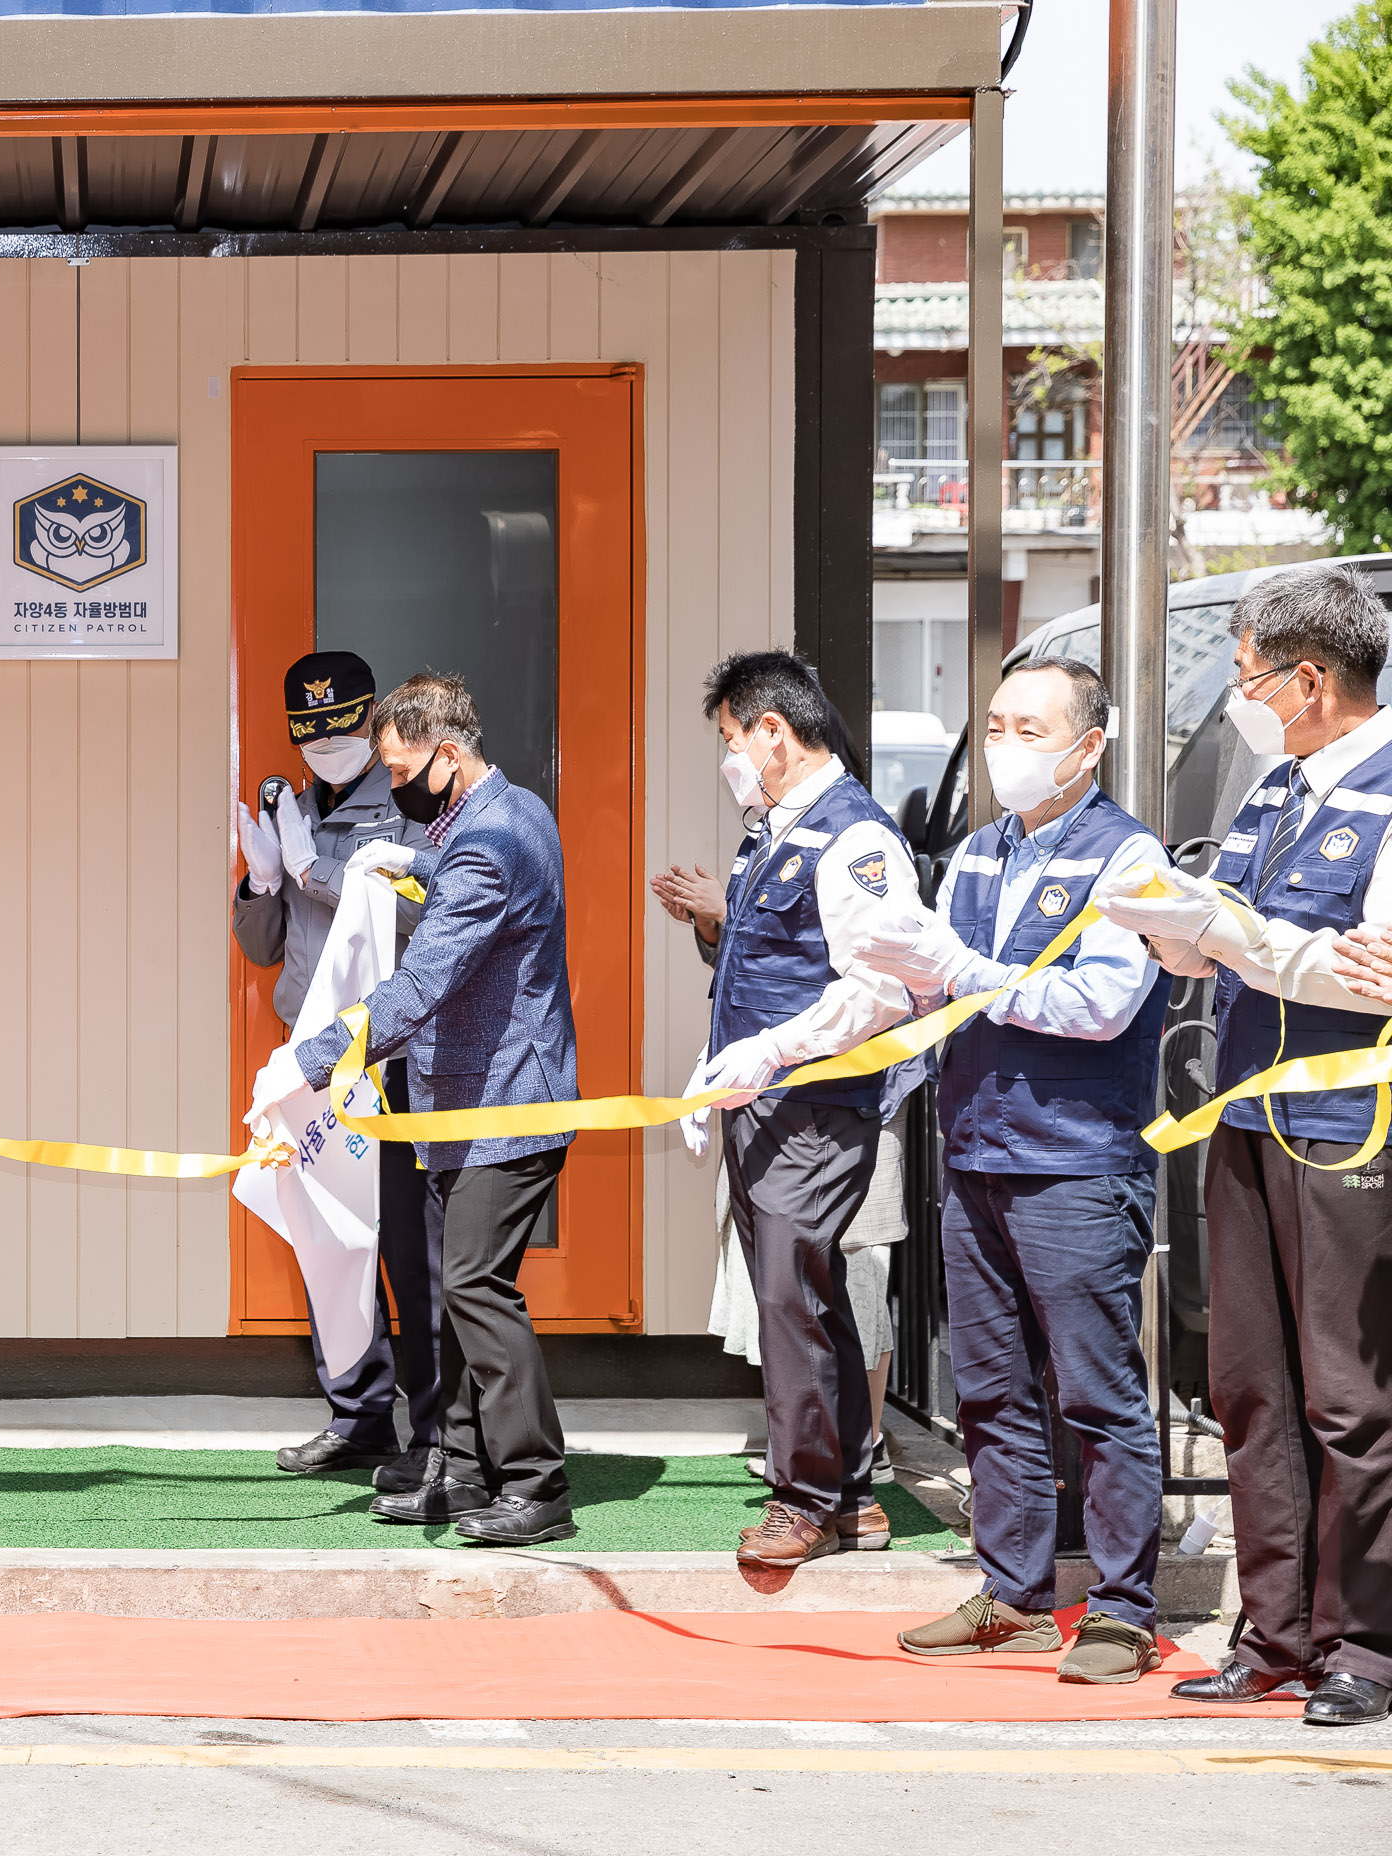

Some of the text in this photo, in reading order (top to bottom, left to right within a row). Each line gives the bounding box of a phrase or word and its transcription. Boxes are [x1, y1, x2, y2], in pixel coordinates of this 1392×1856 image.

[13, 601, 147, 619] 자양4동 자율방범대
[13, 623, 147, 633] CITIZEN PATROL
[1361, 1174, 1384, 1183] KOLON
[1361, 1181, 1384, 1190] SPORT
